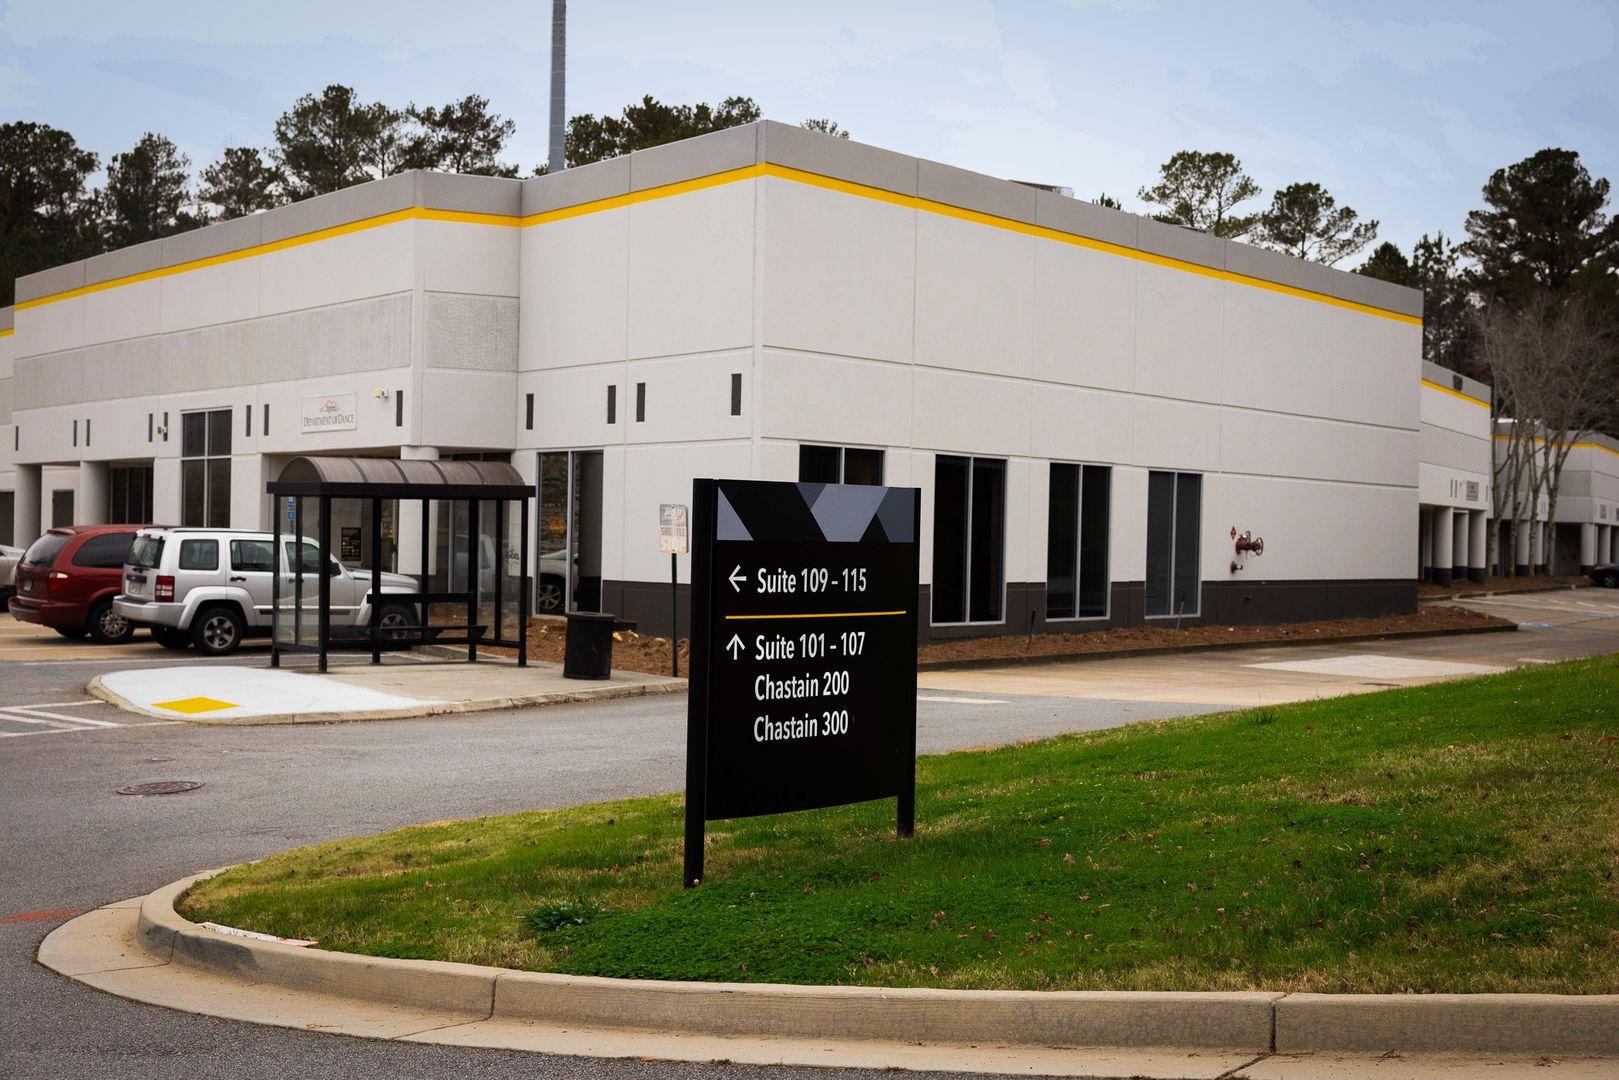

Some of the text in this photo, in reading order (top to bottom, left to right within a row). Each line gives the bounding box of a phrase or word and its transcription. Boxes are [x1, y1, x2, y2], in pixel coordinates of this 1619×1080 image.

[756, 567, 797, 594] Suite
[755, 633, 795, 661] Suite
[754, 670, 850, 701] Chastain 200
[753, 709, 849, 742] Chastain 300
